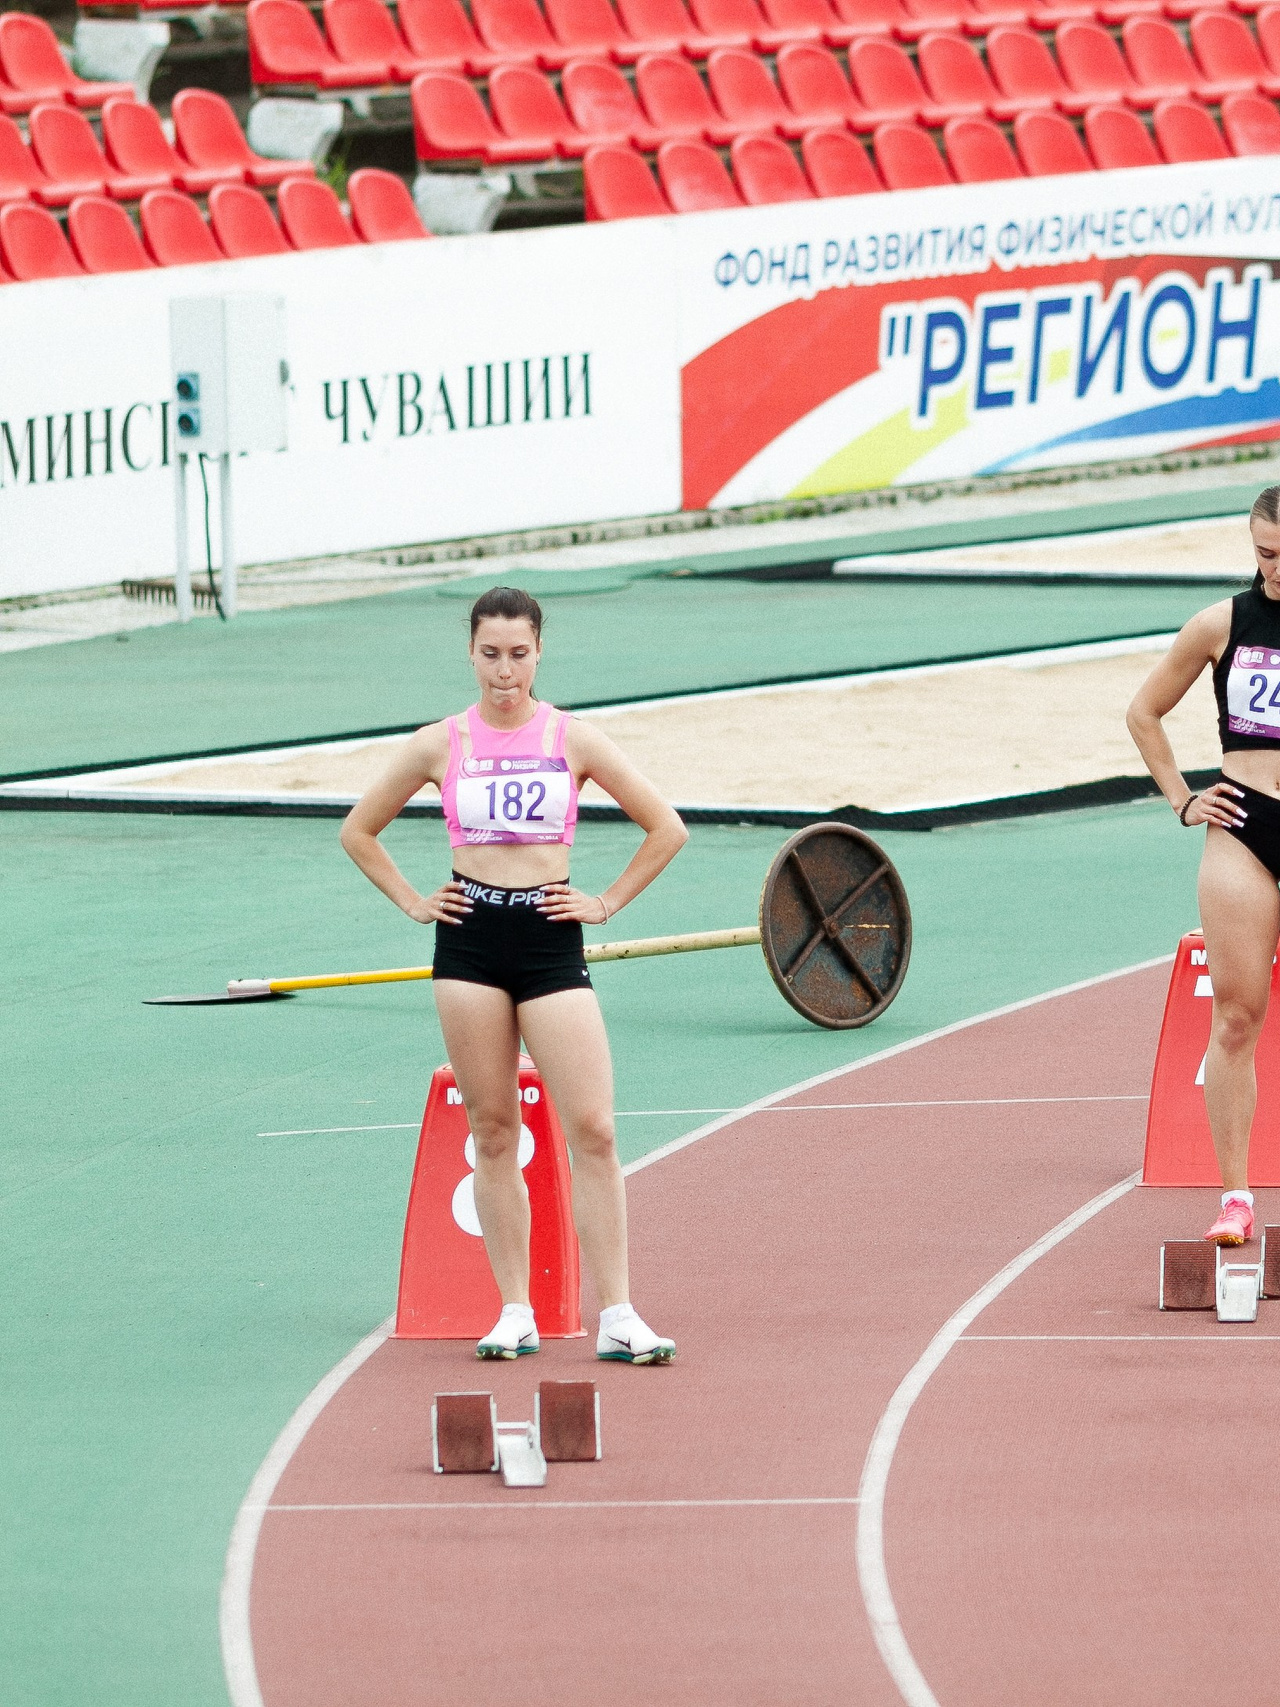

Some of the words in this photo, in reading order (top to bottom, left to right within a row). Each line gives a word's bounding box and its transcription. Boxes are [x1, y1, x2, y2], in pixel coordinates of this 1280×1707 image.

[713, 242, 812, 289] ФОНД
[822, 223, 986, 276] РАЗВИТИЯ
[997, 190, 1214, 257] ФИЗИЧЕСКОЙ
[886, 276, 1262, 418] "РЕГИОН
[322, 352, 593, 444] ЧУВАШИИ
[485, 781, 546, 821] 182
[508, 889, 546, 906] PR
